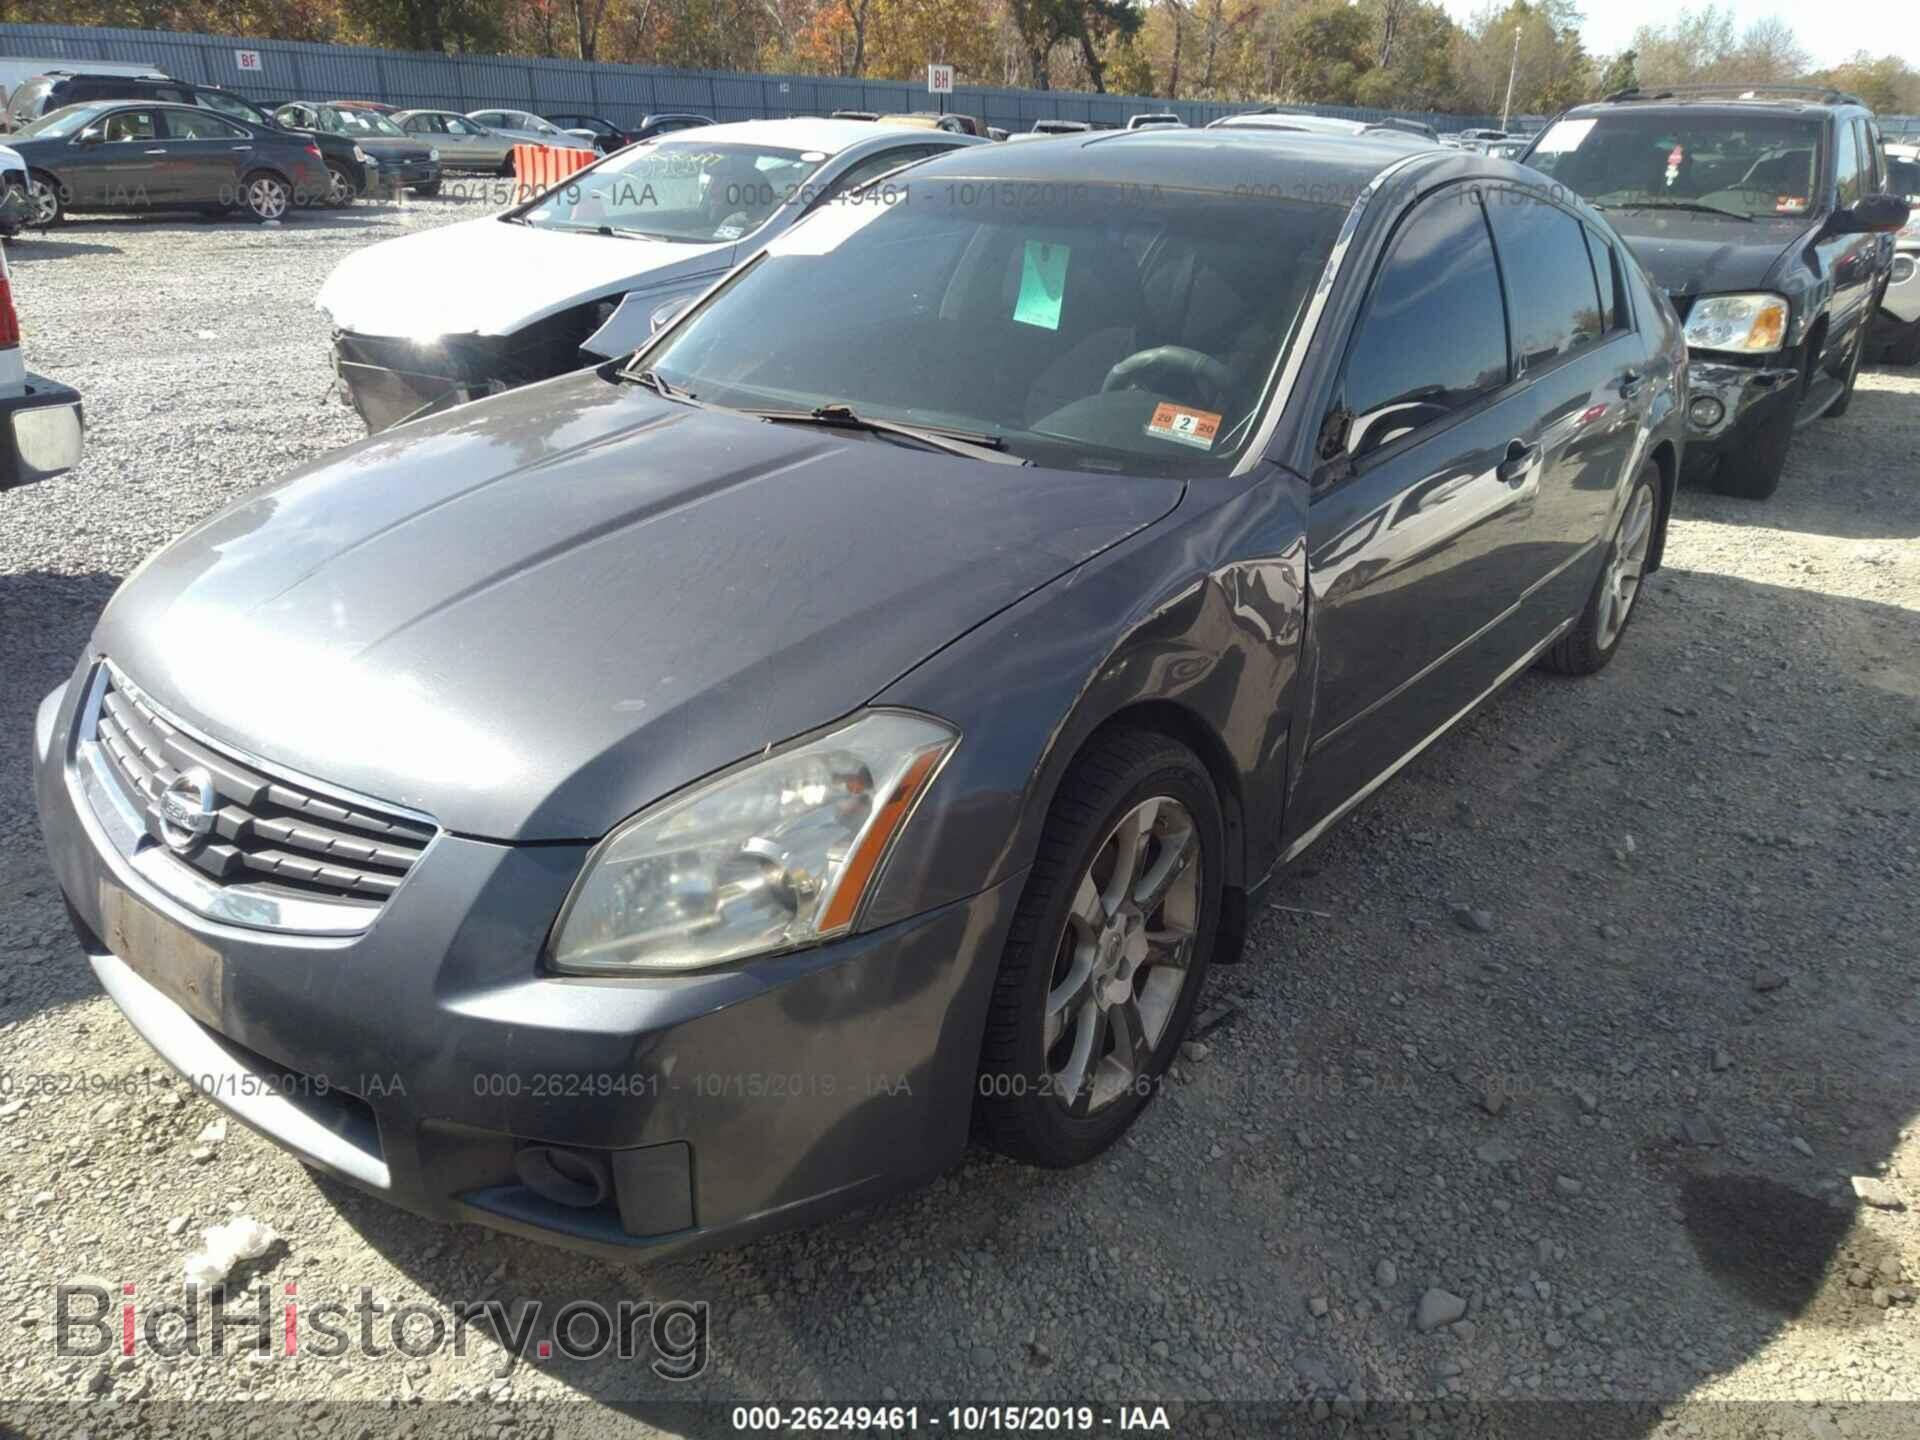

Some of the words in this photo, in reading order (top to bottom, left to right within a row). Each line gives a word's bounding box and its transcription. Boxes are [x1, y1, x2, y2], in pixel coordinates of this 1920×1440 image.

[241, 54, 256, 67] BF
[935, 70, 948, 88] BH
[1179, 417, 1191, 430] 2
[1199, 423, 1214, 433] 20
